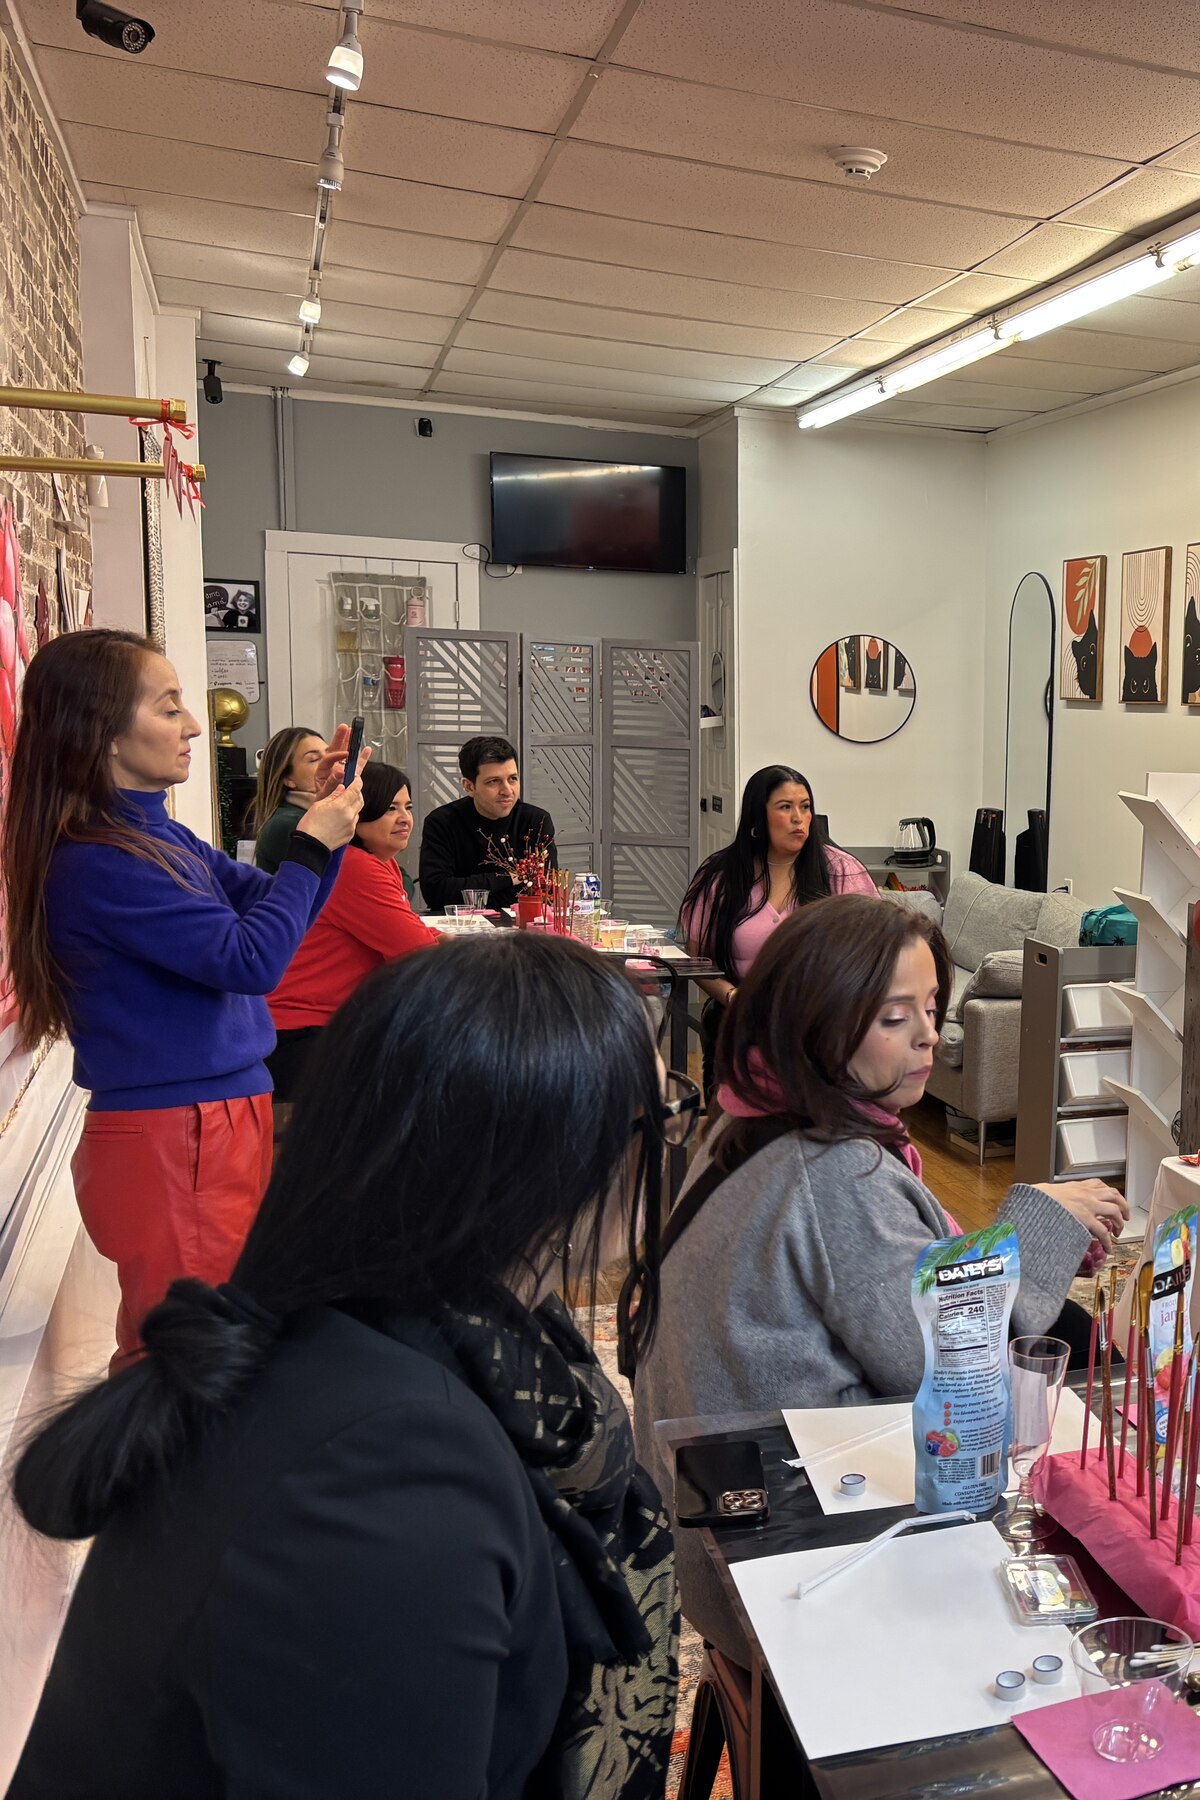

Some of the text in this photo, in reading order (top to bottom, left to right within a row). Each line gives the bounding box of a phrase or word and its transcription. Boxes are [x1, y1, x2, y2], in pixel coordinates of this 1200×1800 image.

[939, 1293, 965, 1301] Nutrition
[939, 1306, 984, 1319] Calories 240
